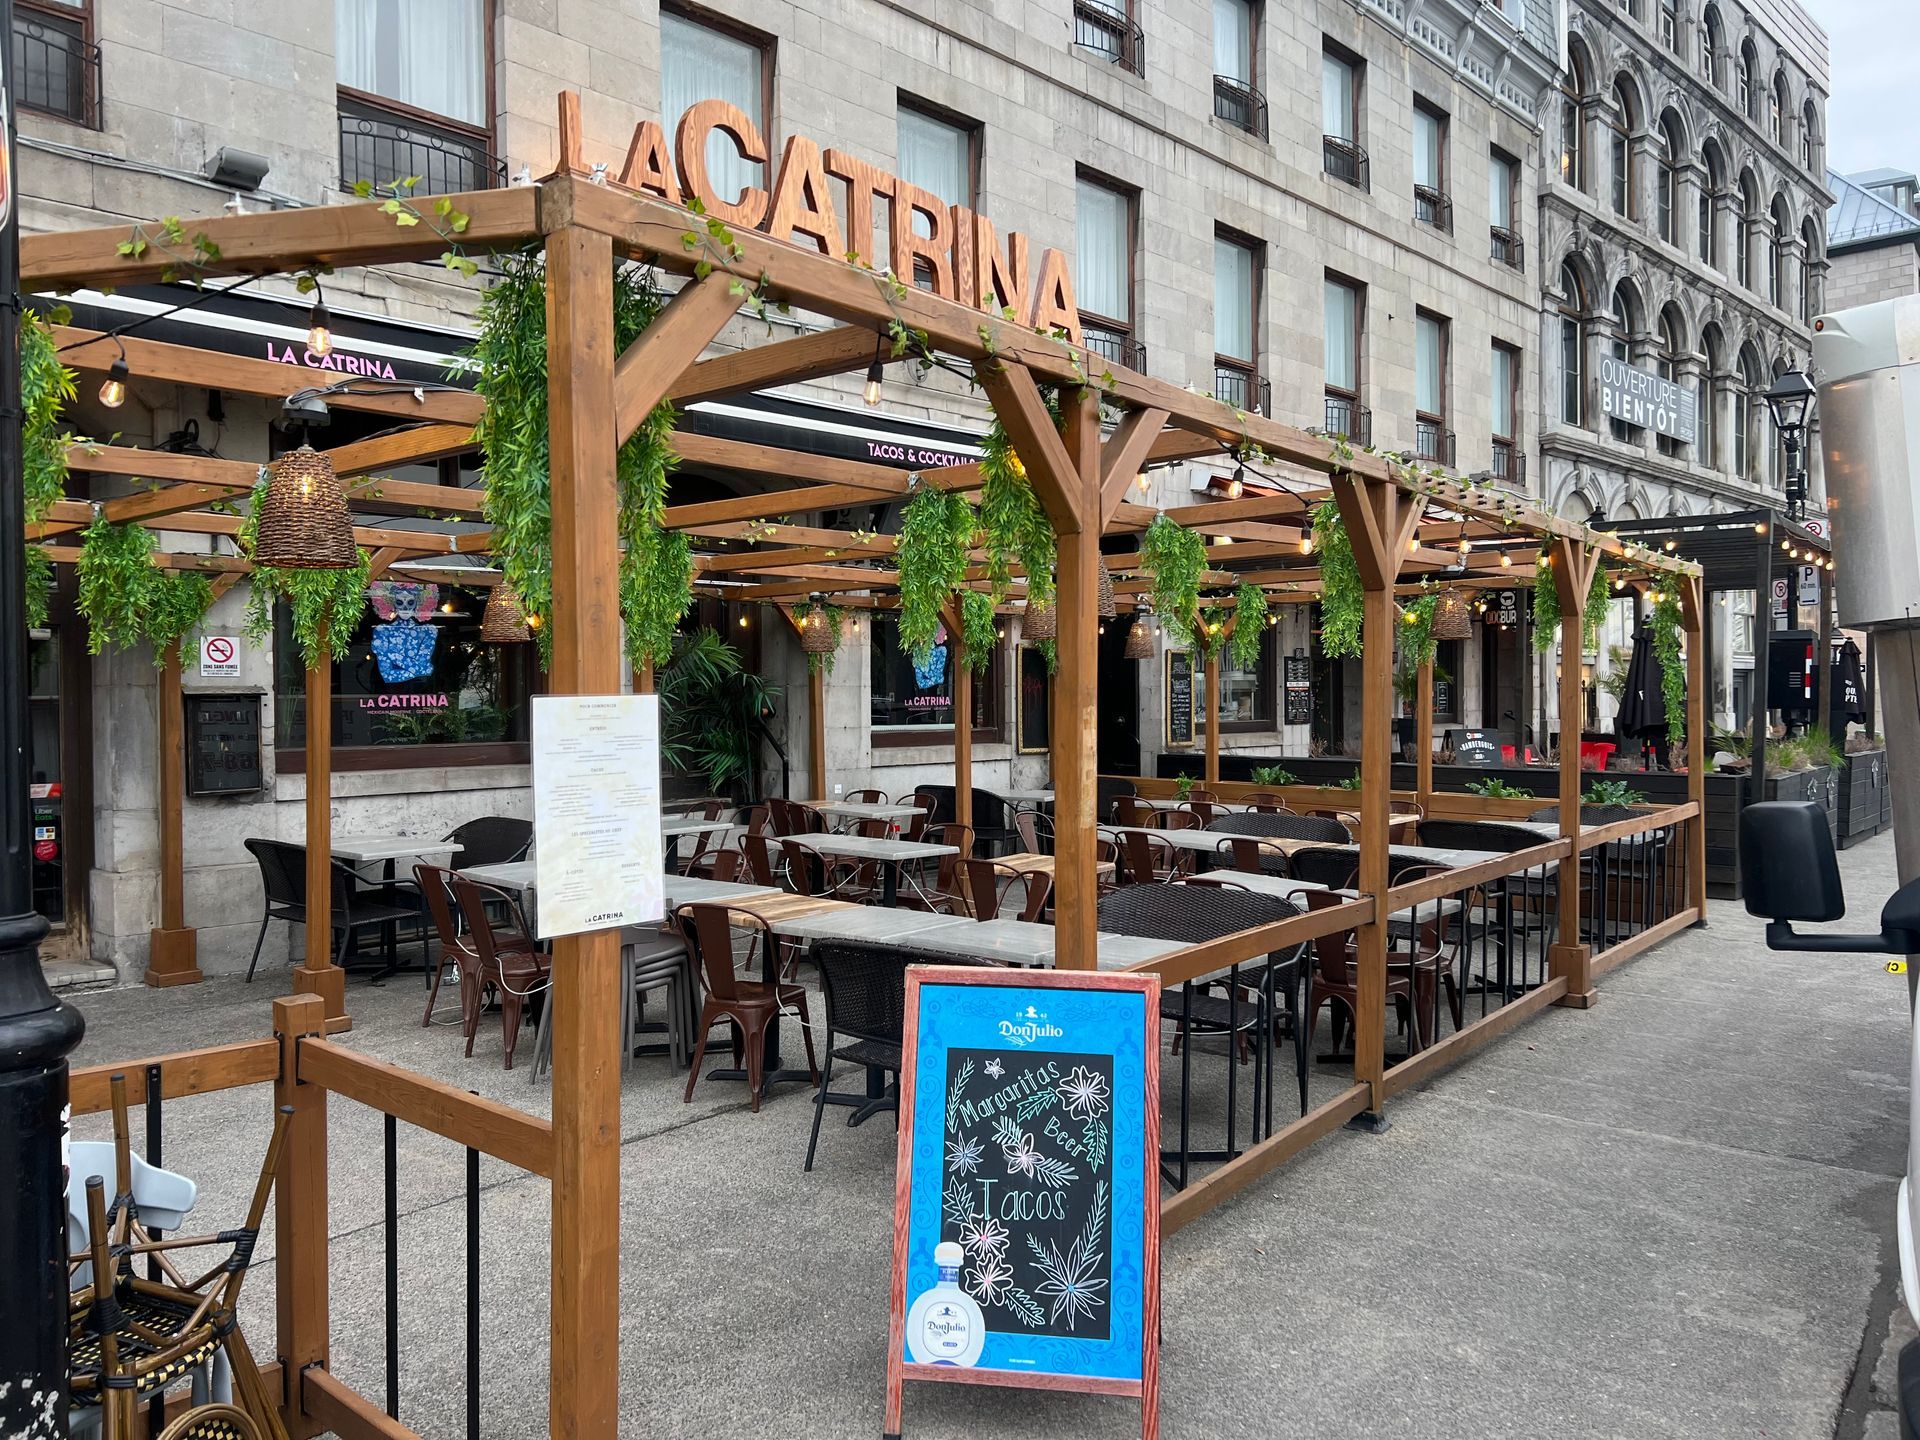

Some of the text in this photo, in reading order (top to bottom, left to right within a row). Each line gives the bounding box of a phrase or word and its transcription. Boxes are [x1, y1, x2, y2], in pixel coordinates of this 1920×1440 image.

[267, 342, 396, 380] LA CATRINA
[1602, 359, 1677, 409] OUVERTURE
[1602, 386, 1677, 435] BIENTÔT
[867, 442, 905, 461] TACOS
[907, 448, 917, 462] &
[359, 694, 449, 708] LA CATRINA
[913, 696, 951, 706] CATRINA
[592, 911, 624, 922] CATRINA
[959, 1061, 1060, 1128] Margaritas
[1044, 1115, 1088, 1158] Beer
[975, 1178, 1067, 1221] Tacos
